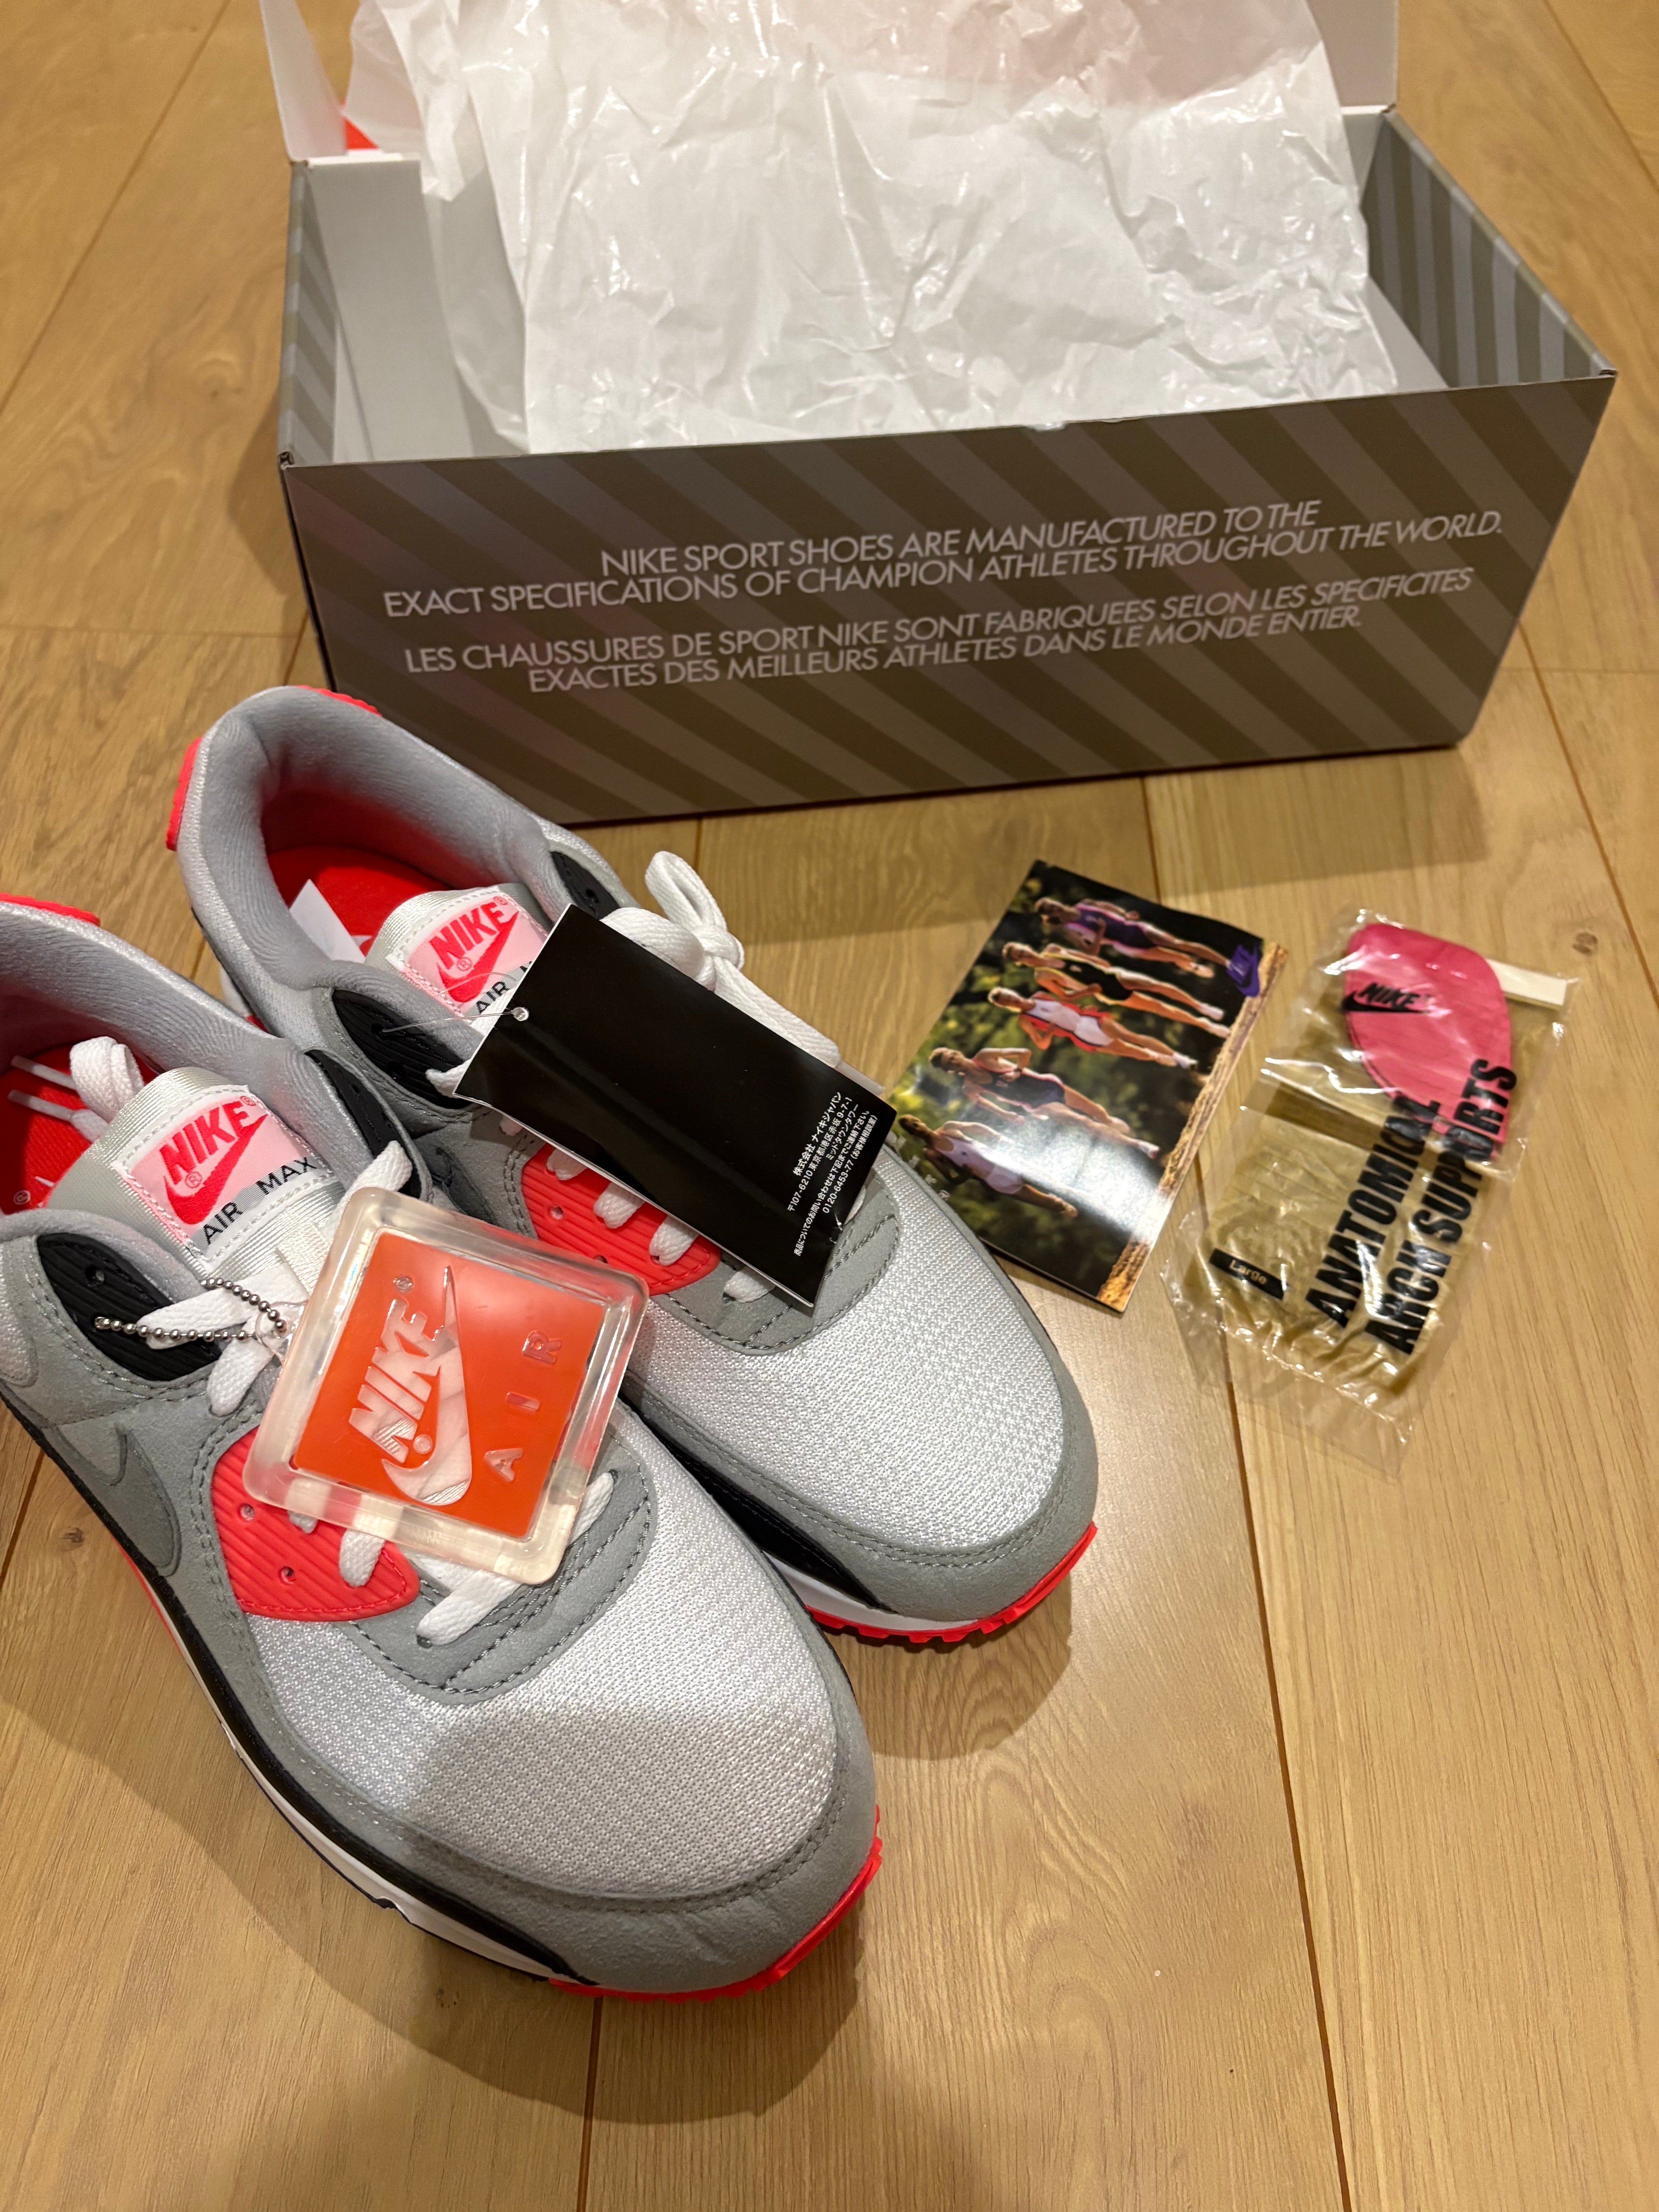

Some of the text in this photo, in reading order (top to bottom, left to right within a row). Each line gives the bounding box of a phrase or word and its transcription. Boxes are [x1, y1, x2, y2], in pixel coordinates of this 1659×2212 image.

[383, 510, 1502, 617] EXACT SPECIFICATIONS OF CHAMPION ATHLETES THROUGHOUT THE WORLD.
[601, 499, 1322, 577] NIKE SPORT SHOES ARE MANUFACTURED TO THE
[404, 567, 1474, 673] LES CHAUSSURES DE SPORT NIKE SONT FABRIQUEES SELON LES SPECIFICITES
[528, 605, 1362, 693] EXACTES DES MEILLEURS ATHLETES DANS LE MONDE ENTIER.
[429, 902, 505, 970] NIKE
[476, 981, 511, 1015] AIR
[1358, 982, 1420, 1010] NIKE
[159, 1101, 251, 1185] NIKE
[792, 1092, 841, 1176] 株式会社 ナイキジャパン
[825, 1104, 859, 1160] ミッドタウンタワー
[203, 1157, 318, 1245] AIR MAX
[823, 1159, 854, 1213] 0120-6453-77
[1229, 1260, 1267, 1285] Large
[1365, 1239, 1452, 1355] ARCH
[349, 1298, 436, 1463] NIKE
[483, 1329, 562, 1482] AIR
